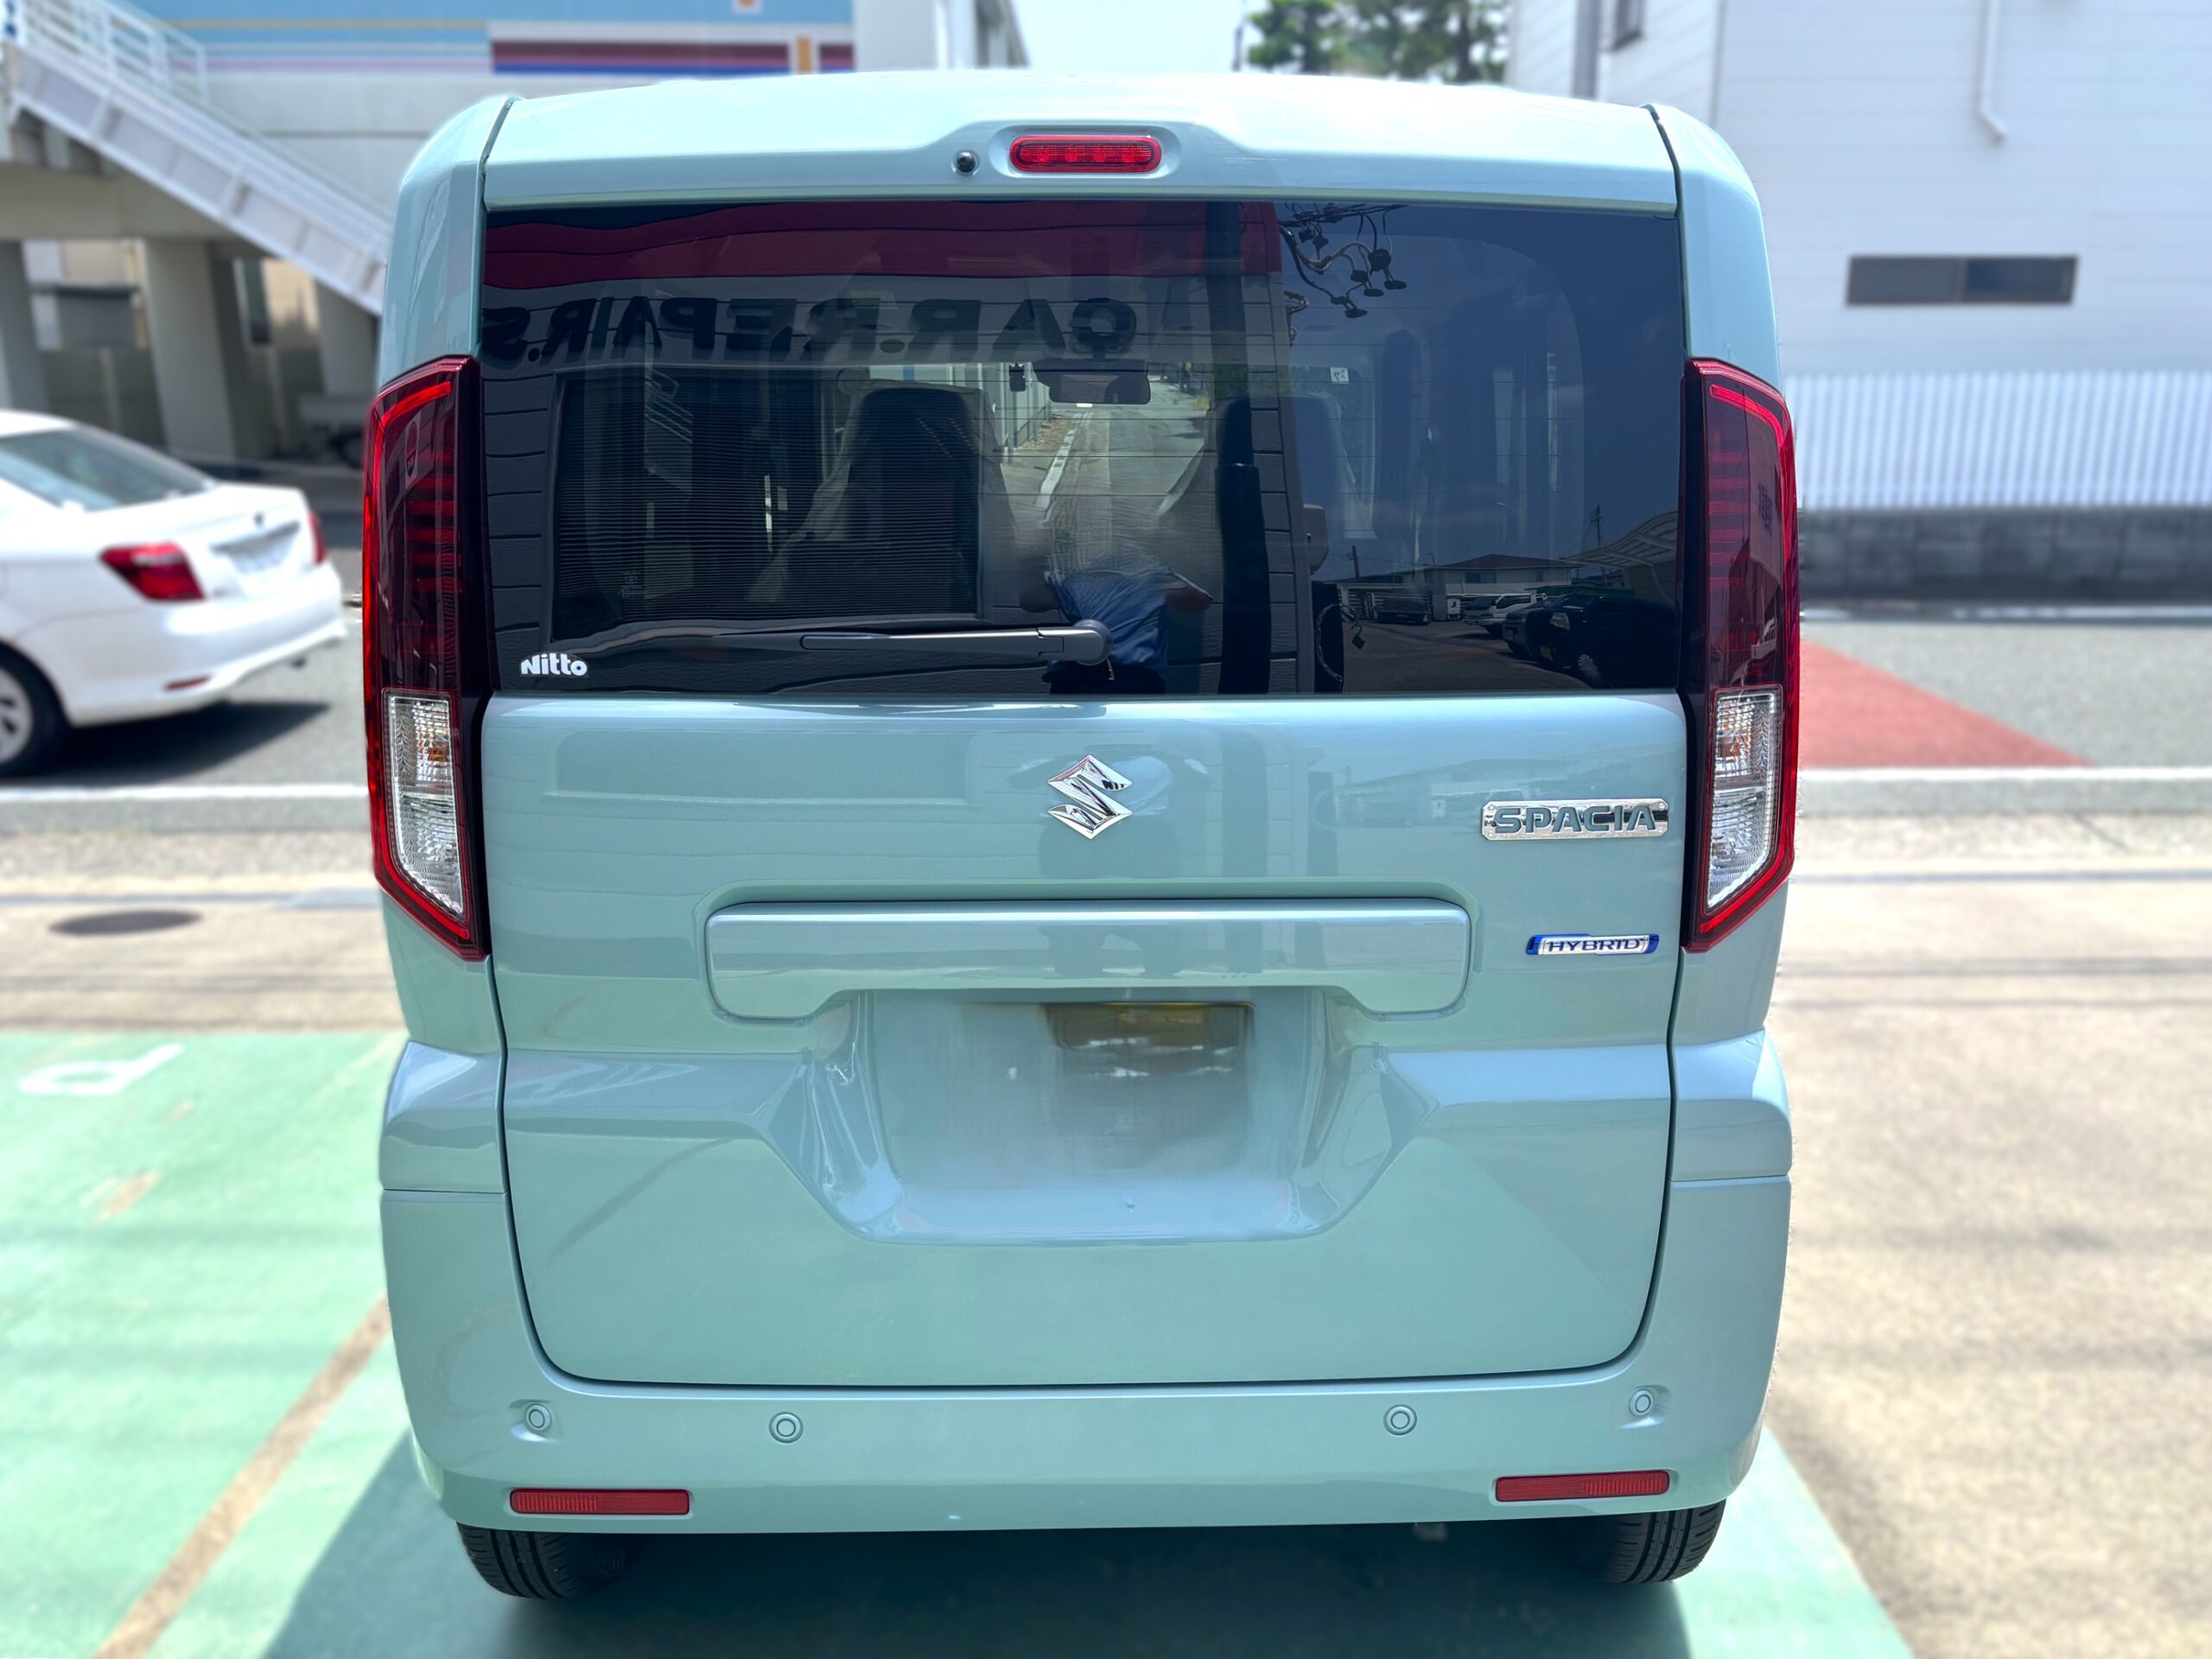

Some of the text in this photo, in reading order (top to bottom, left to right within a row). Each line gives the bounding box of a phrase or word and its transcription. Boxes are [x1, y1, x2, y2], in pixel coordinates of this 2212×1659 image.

[520, 652, 588, 677] Nitto
[1493, 804, 1656, 834] SPACIA
[1548, 938, 1641, 952] HYBRID
